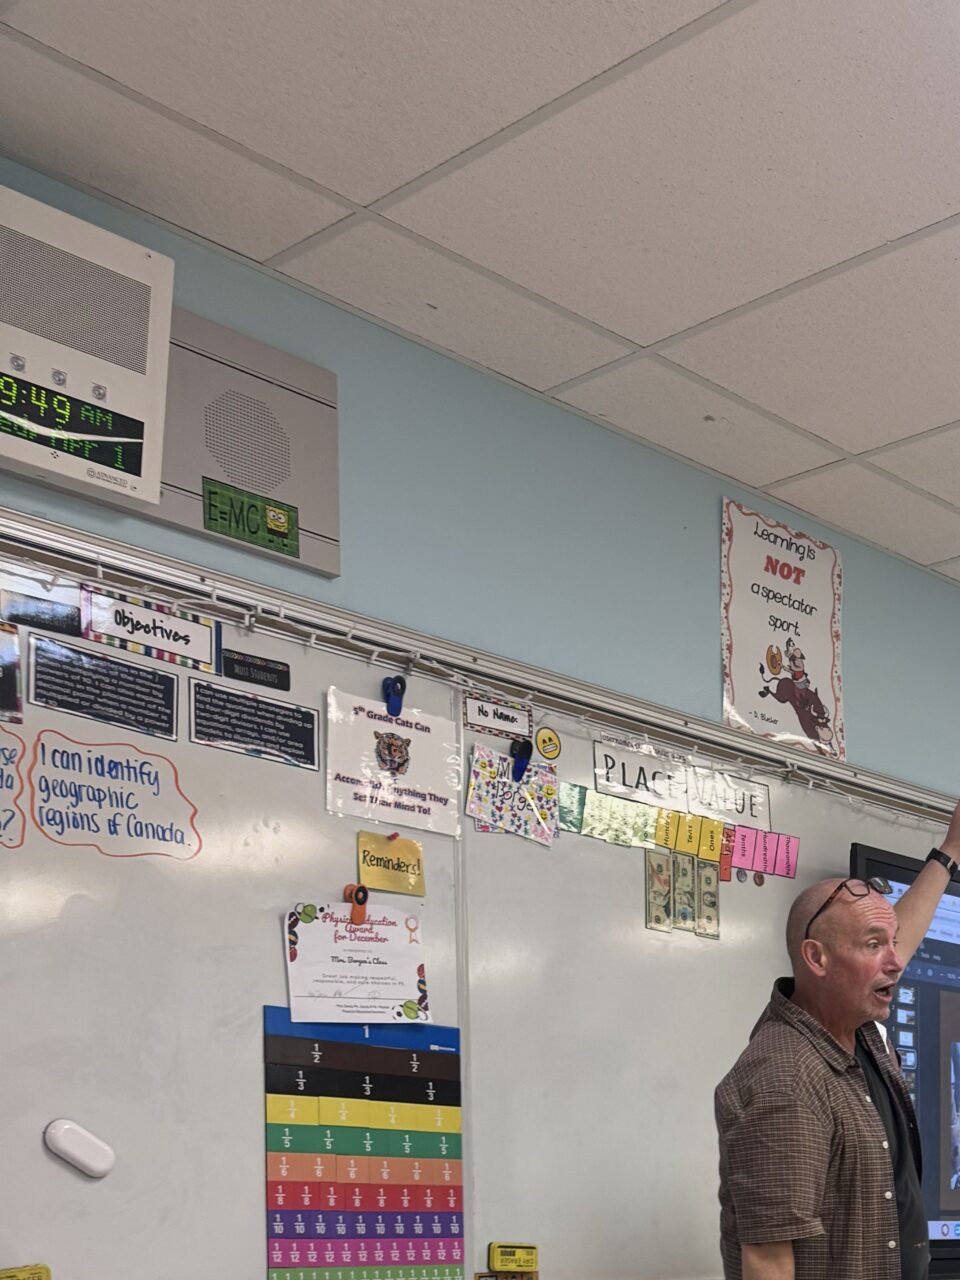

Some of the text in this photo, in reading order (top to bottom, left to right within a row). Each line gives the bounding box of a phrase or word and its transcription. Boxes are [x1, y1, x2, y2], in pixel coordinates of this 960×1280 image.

[753, 521, 808, 561] Learning
[764, 554, 806, 586] NOT
[751, 582, 818, 617] a spectator
[114, 608, 191, 646] Objectives
[768, 614, 801, 637] sport.
[366, 710, 395, 724] Grade
[394, 717, 414, 729] Cats
[414, 722, 432, 734] Can
[477, 704, 489, 718] No
[40, 742, 47, 766] I
[51, 748, 83, 773] can
[87, 750, 161, 797] identify
[38, 774, 140, 809] geographic
[427, 792, 449, 807] They
[38, 805, 101, 836] regions
[107, 812, 125, 836] of
[393, 801, 416, 812] Mind
[416, 805, 432, 816] To!
[361, 849, 421, 876] Reminders!
